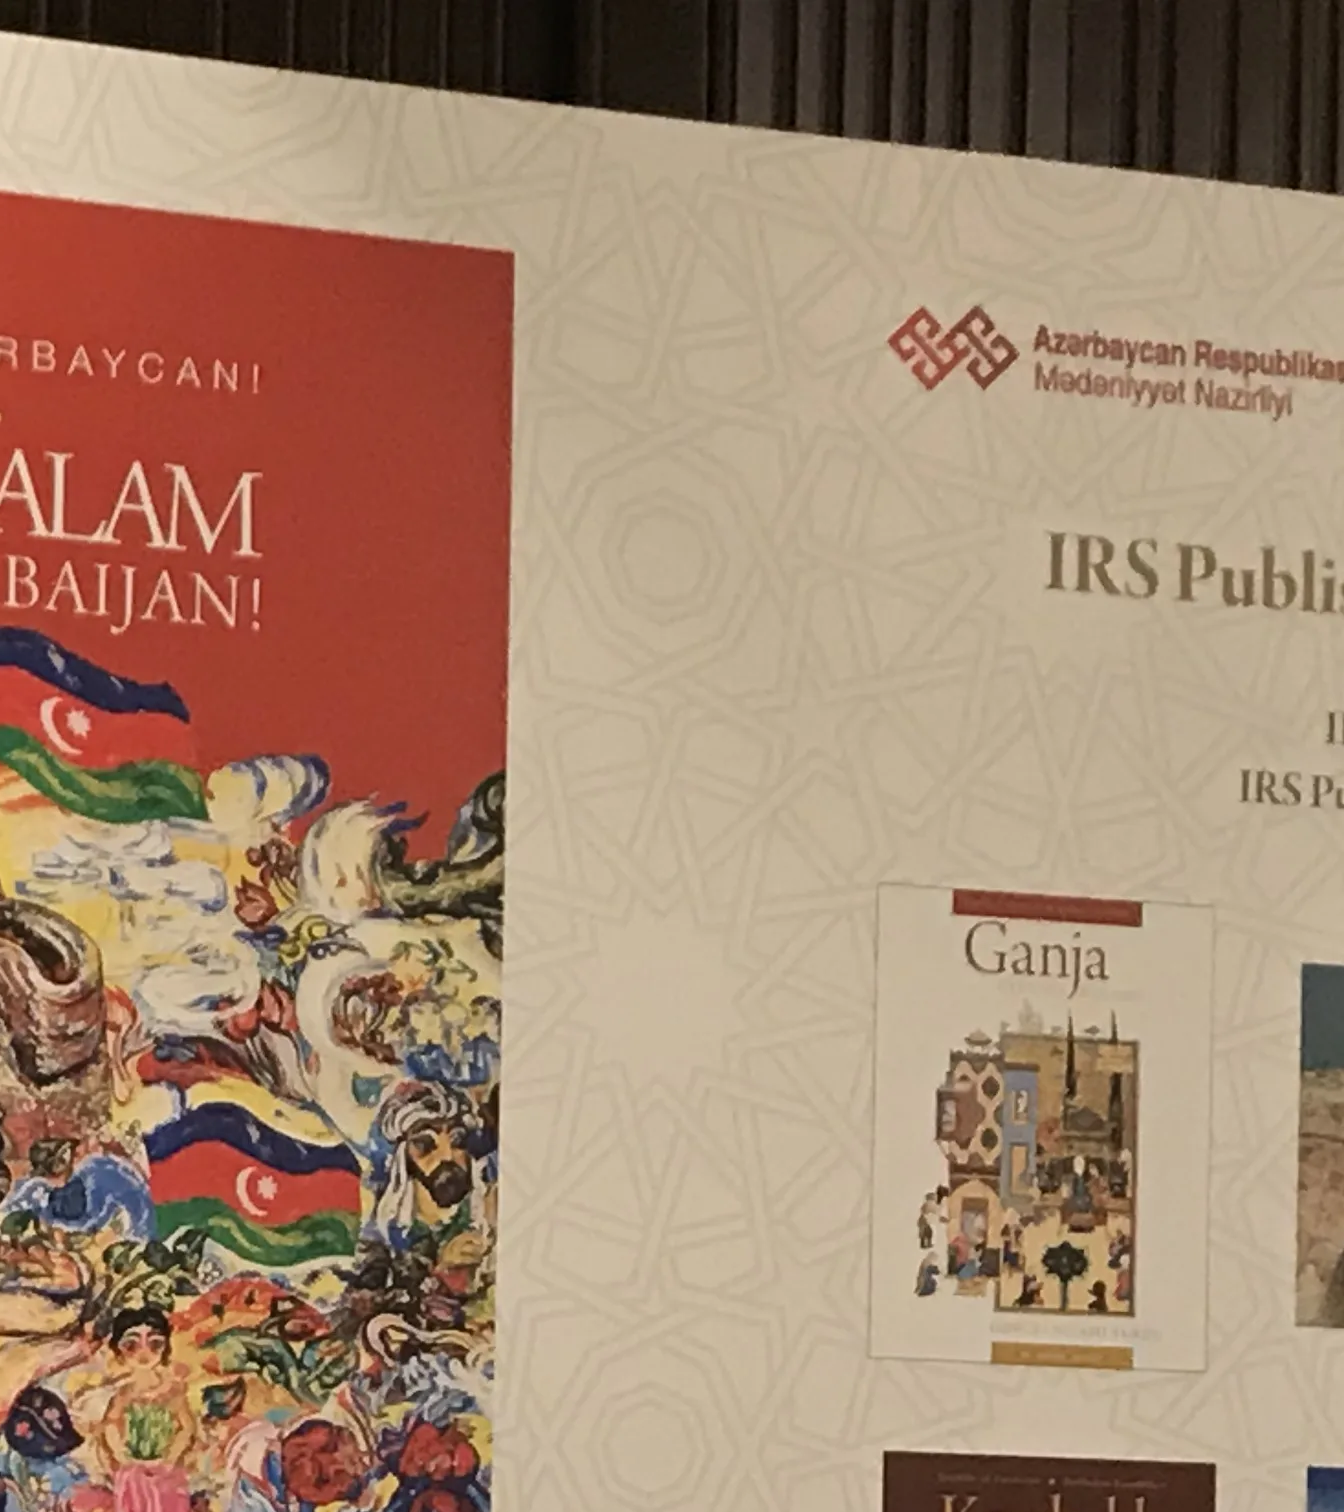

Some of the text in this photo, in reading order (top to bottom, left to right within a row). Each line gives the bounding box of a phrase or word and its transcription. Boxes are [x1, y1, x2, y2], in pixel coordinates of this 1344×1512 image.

[1033, 324, 1187, 370] Azərbaycan
[1034, 361, 1294, 422] Mədəniyyət Nazirliyi
[1044, 529, 1159, 600] IRS
[1239, 767, 1302, 807] IRS
[964, 920, 1109, 998] Ganja
